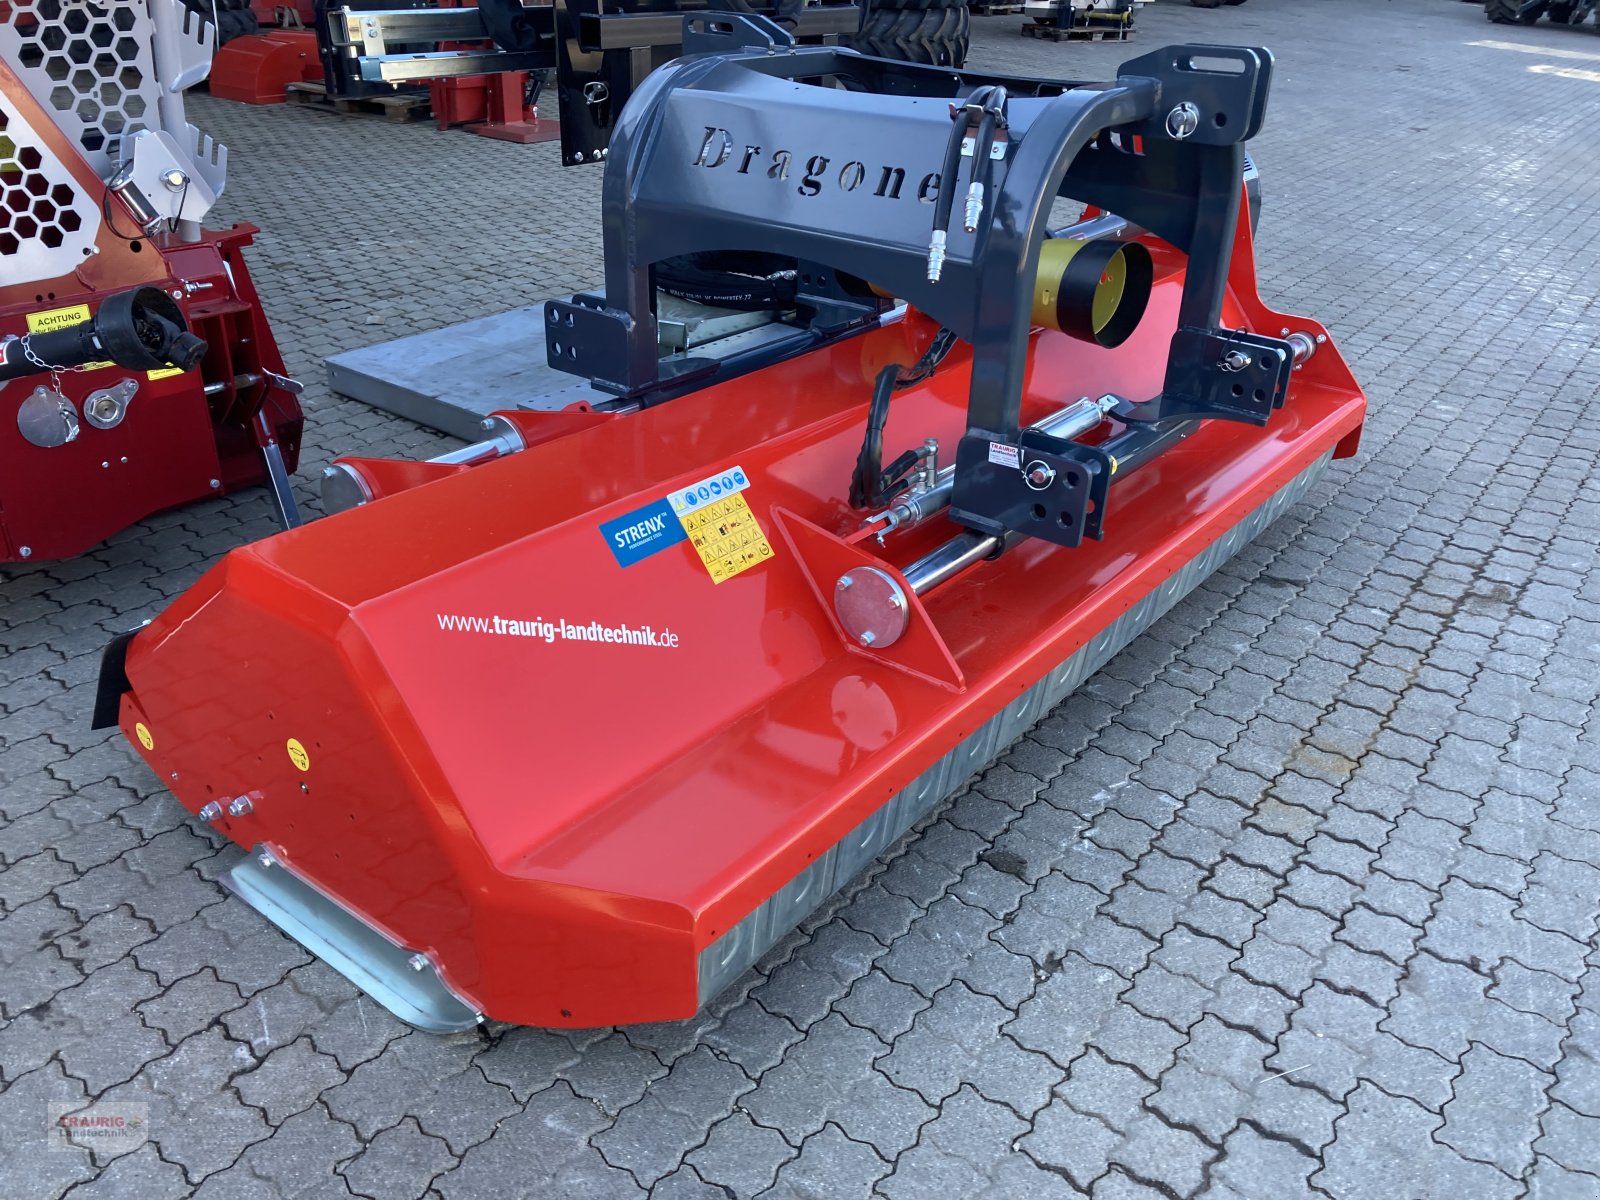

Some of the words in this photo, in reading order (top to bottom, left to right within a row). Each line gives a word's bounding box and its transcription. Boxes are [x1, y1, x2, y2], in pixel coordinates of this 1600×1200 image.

[692, 126, 942, 204] Dragone
[38, 312, 81, 326] ACHTUNG
[436, 613, 680, 648] www.traurig-landtechnik.de
